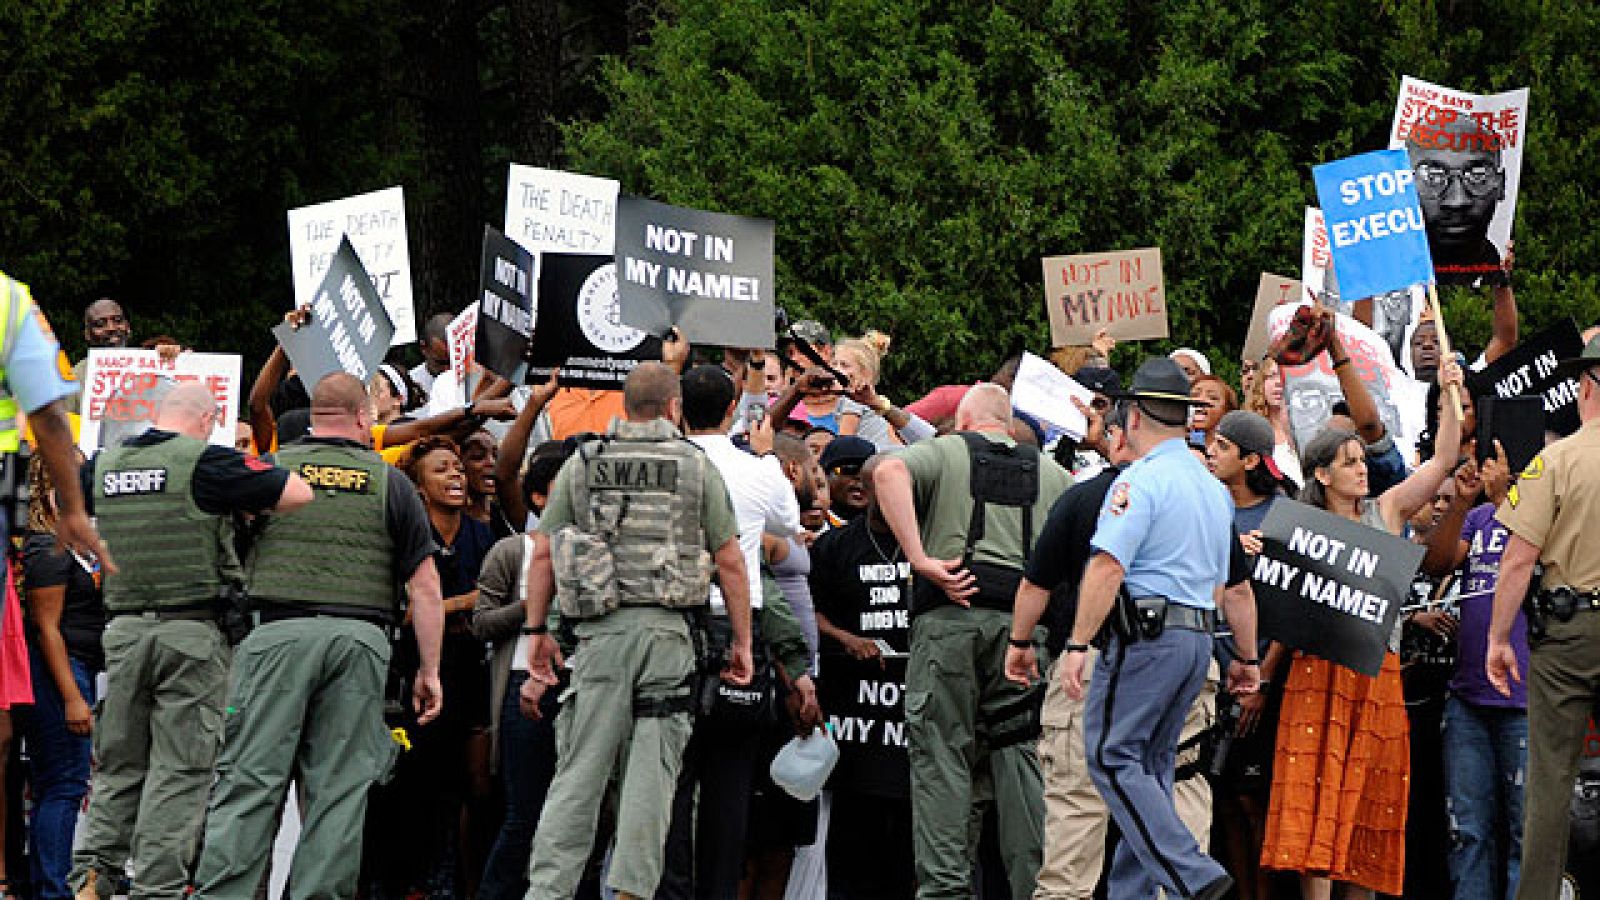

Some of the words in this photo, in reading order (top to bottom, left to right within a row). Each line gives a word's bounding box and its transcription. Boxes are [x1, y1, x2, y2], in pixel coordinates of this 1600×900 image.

[1402, 97, 1458, 129] STOP
[1470, 108, 1519, 131] THE
[1397, 119, 1518, 153] EXECUTION
[520, 182, 551, 211] THE
[560, 189, 613, 226] DEATH
[1340, 169, 1415, 206] STOP
[524, 216, 602, 249] PENALTY
[645, 223, 698, 257] NOT
[714, 234, 735, 263] IN
[625, 256, 661, 288] MY
[666, 266, 760, 301] NAME!
[1061, 260, 1109, 285] NOT
[1119, 256, 1141, 285] IN
[313, 288, 339, 329] MY
[339, 273, 367, 321] NOT
[356, 310, 376, 346] IN
[1061, 289, 1104, 325] MY
[1106, 285, 1161, 322] NAME
[92, 369, 158, 396] STOP
[1495, 365, 1534, 398] NOT
[1534, 349, 1558, 379] IN
[104, 469, 166, 497] SHERIFF
[303, 463, 368, 491] SHERIFF
[1288, 526, 1346, 566] NOT
[1347, 546, 1380, 578] IN
[1253, 554, 1299, 591] MY
[1299, 571, 1389, 624] NAME!
[829, 714, 876, 744] MY
